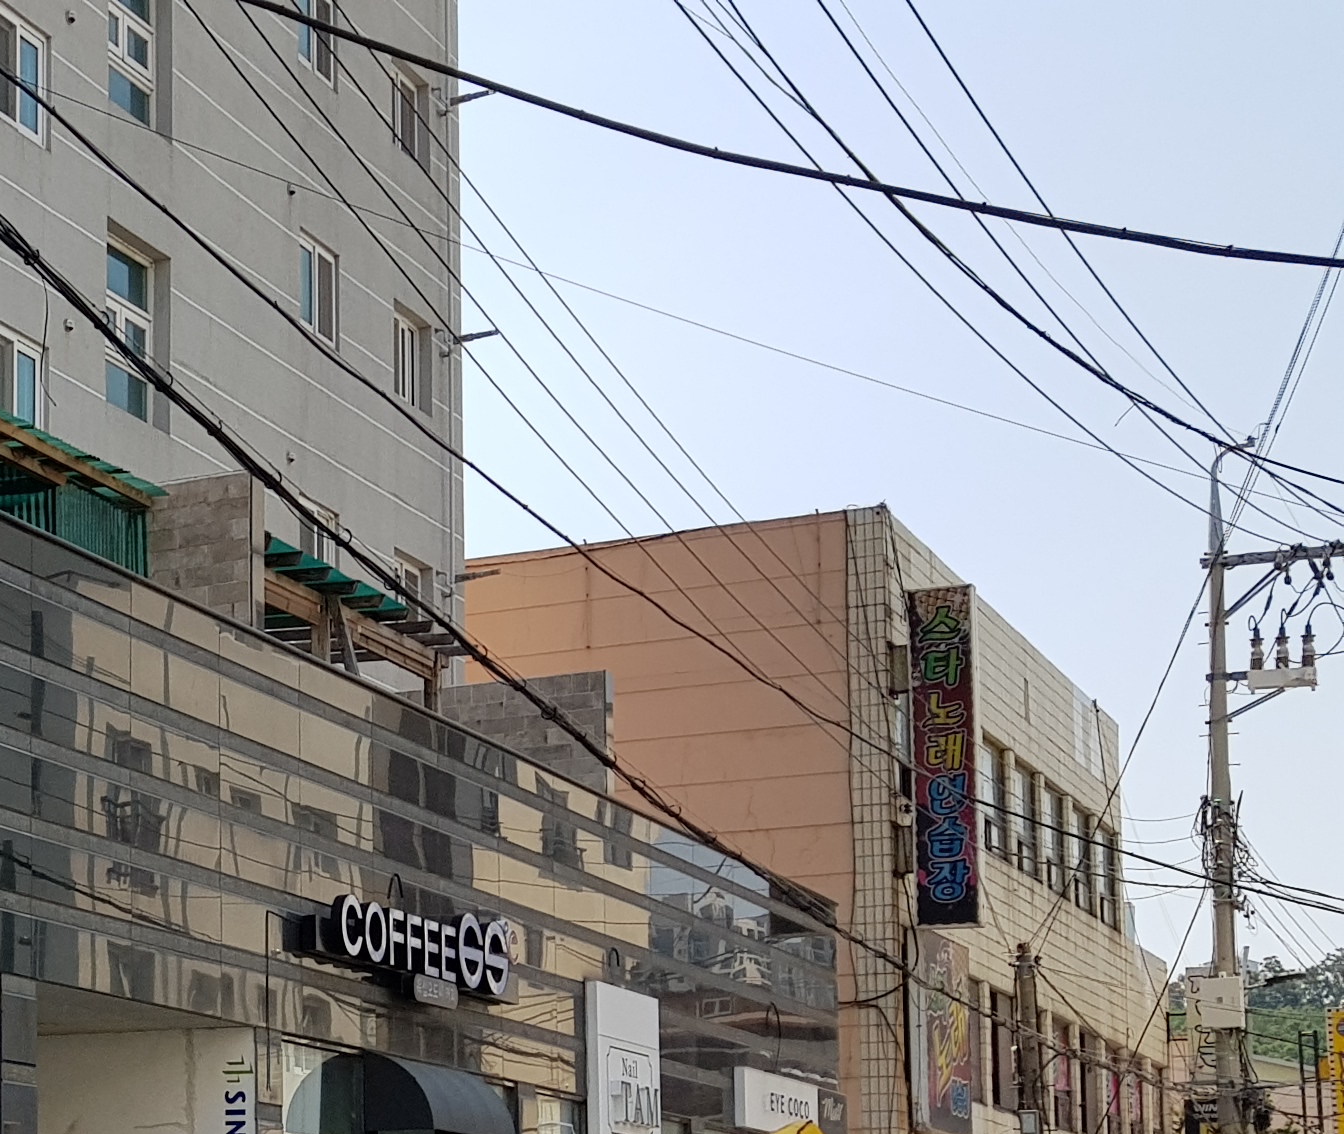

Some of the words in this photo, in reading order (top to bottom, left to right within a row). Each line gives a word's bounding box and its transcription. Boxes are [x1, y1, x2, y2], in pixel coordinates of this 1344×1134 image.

[918, 605, 974, 904] 스타노래연습장
[621, 1057, 639, 1079] Nail
[621, 1080, 660, 1128] TAM
[769, 1091, 785, 1114] EYE
[787, 1096, 810, 1120] COCO
